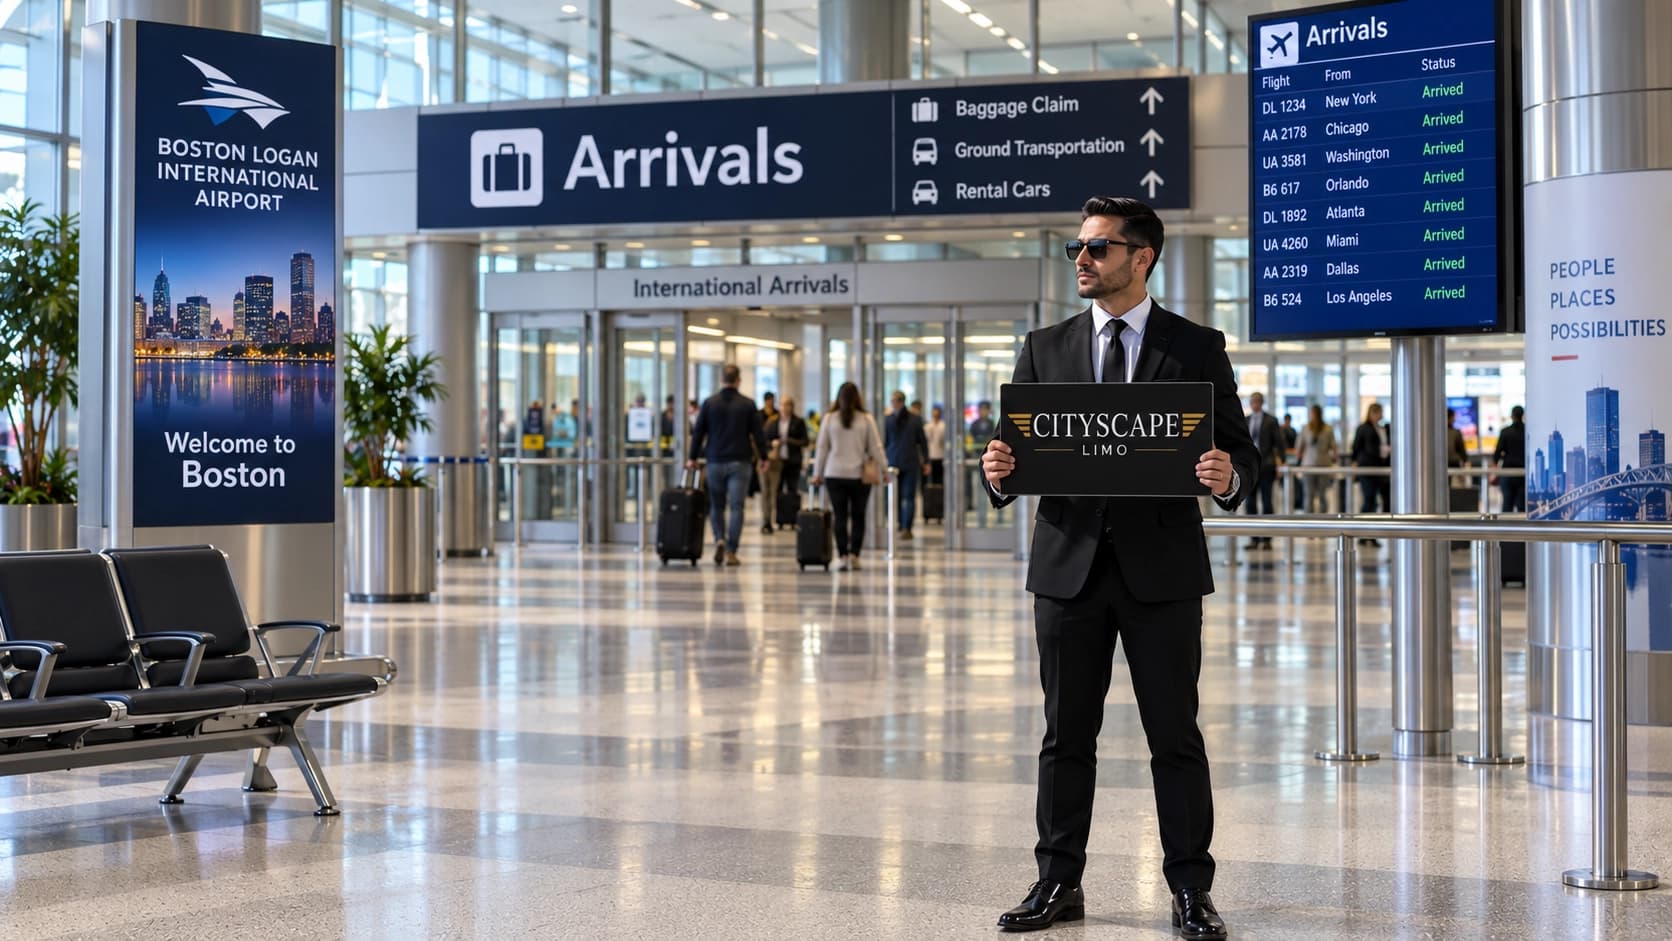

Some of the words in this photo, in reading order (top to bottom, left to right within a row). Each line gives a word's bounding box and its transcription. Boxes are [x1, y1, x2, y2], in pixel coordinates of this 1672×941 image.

[1306, 16, 1387, 47] Arrivals
[1263, 75, 1290, 90] Flight
[1325, 69, 1351, 81] From
[1422, 58, 1455, 70] Status
[956, 100, 1027, 119] Baggage
[1031, 96, 1078, 113] Claim
[1263, 102, 1276, 114] DL
[1281, 99, 1305, 112] 1234
[1326, 96, 1349, 108] New
[1352, 91, 1376, 104] York
[1422, 81, 1463, 98] Arrived
[1263, 129, 1278, 141] AA
[1281, 126, 1307, 140] 2178
[1326, 122, 1369, 136] Chicago
[1423, 110, 1463, 127] Arrived
[159, 138, 245, 161] BOSTON
[253, 146, 317, 168] LOGAN
[564, 126, 803, 190] Arrivals
[955, 140, 1010, 158] Ground
[1014, 137, 1124, 159] Transportation
[1263, 156, 1278, 169] UA
[1282, 153, 1306, 167] 3581
[1326, 148, 1389, 163] Washington
[1423, 139, 1463, 155] Arrived
[158, 161, 318, 191] INTERNATIONAL
[1264, 184, 1277, 196] B6
[1281, 182, 1300, 195] 617
[1326, 176, 1369, 191] Orlando
[1423, 167, 1464, 184] Arrived
[195, 190, 283, 211] AIRPORT
[957, 181, 1006, 199] Rental
[1012, 181, 1050, 198] Cars
[1264, 211, 1278, 224] DL
[1281, 209, 1307, 222] 1892
[1326, 206, 1364, 219] Atlanta
[1424, 197, 1464, 212] Arrived
[1264, 239, 1278, 251] UA
[1282, 237, 1308, 250] 4260
[1327, 233, 1358, 247] Miami
[1424, 226, 1464, 241] Arrived
[1264, 266, 1279, 279] AA
[1282, 265, 1307, 278] 2319
[1327, 262, 1359, 275] Dallas
[1424, 255, 1464, 270] Arrived
[1551, 258, 1615, 279] PEOPLE
[634, 275, 761, 297] International
[769, 274, 848, 294] Arrivals
[1264, 294, 1278, 306] B6
[1282, 293, 1302, 305] 524
[1327, 291, 1345, 303] Los
[1348, 289, 1392, 305] Angeles
[1424, 284, 1465, 299] Arrived
[1551, 289, 1615, 309] PLACES
[1551, 319, 1665, 340] POSSIBILITIES
[1034, 413, 1179, 437] CITYSCAPE
[164, 432, 267, 453] Welcome
[274, 435, 295, 453] to
[1083, 445, 1127, 457] LIMO
[183, 460, 285, 487] Boston
